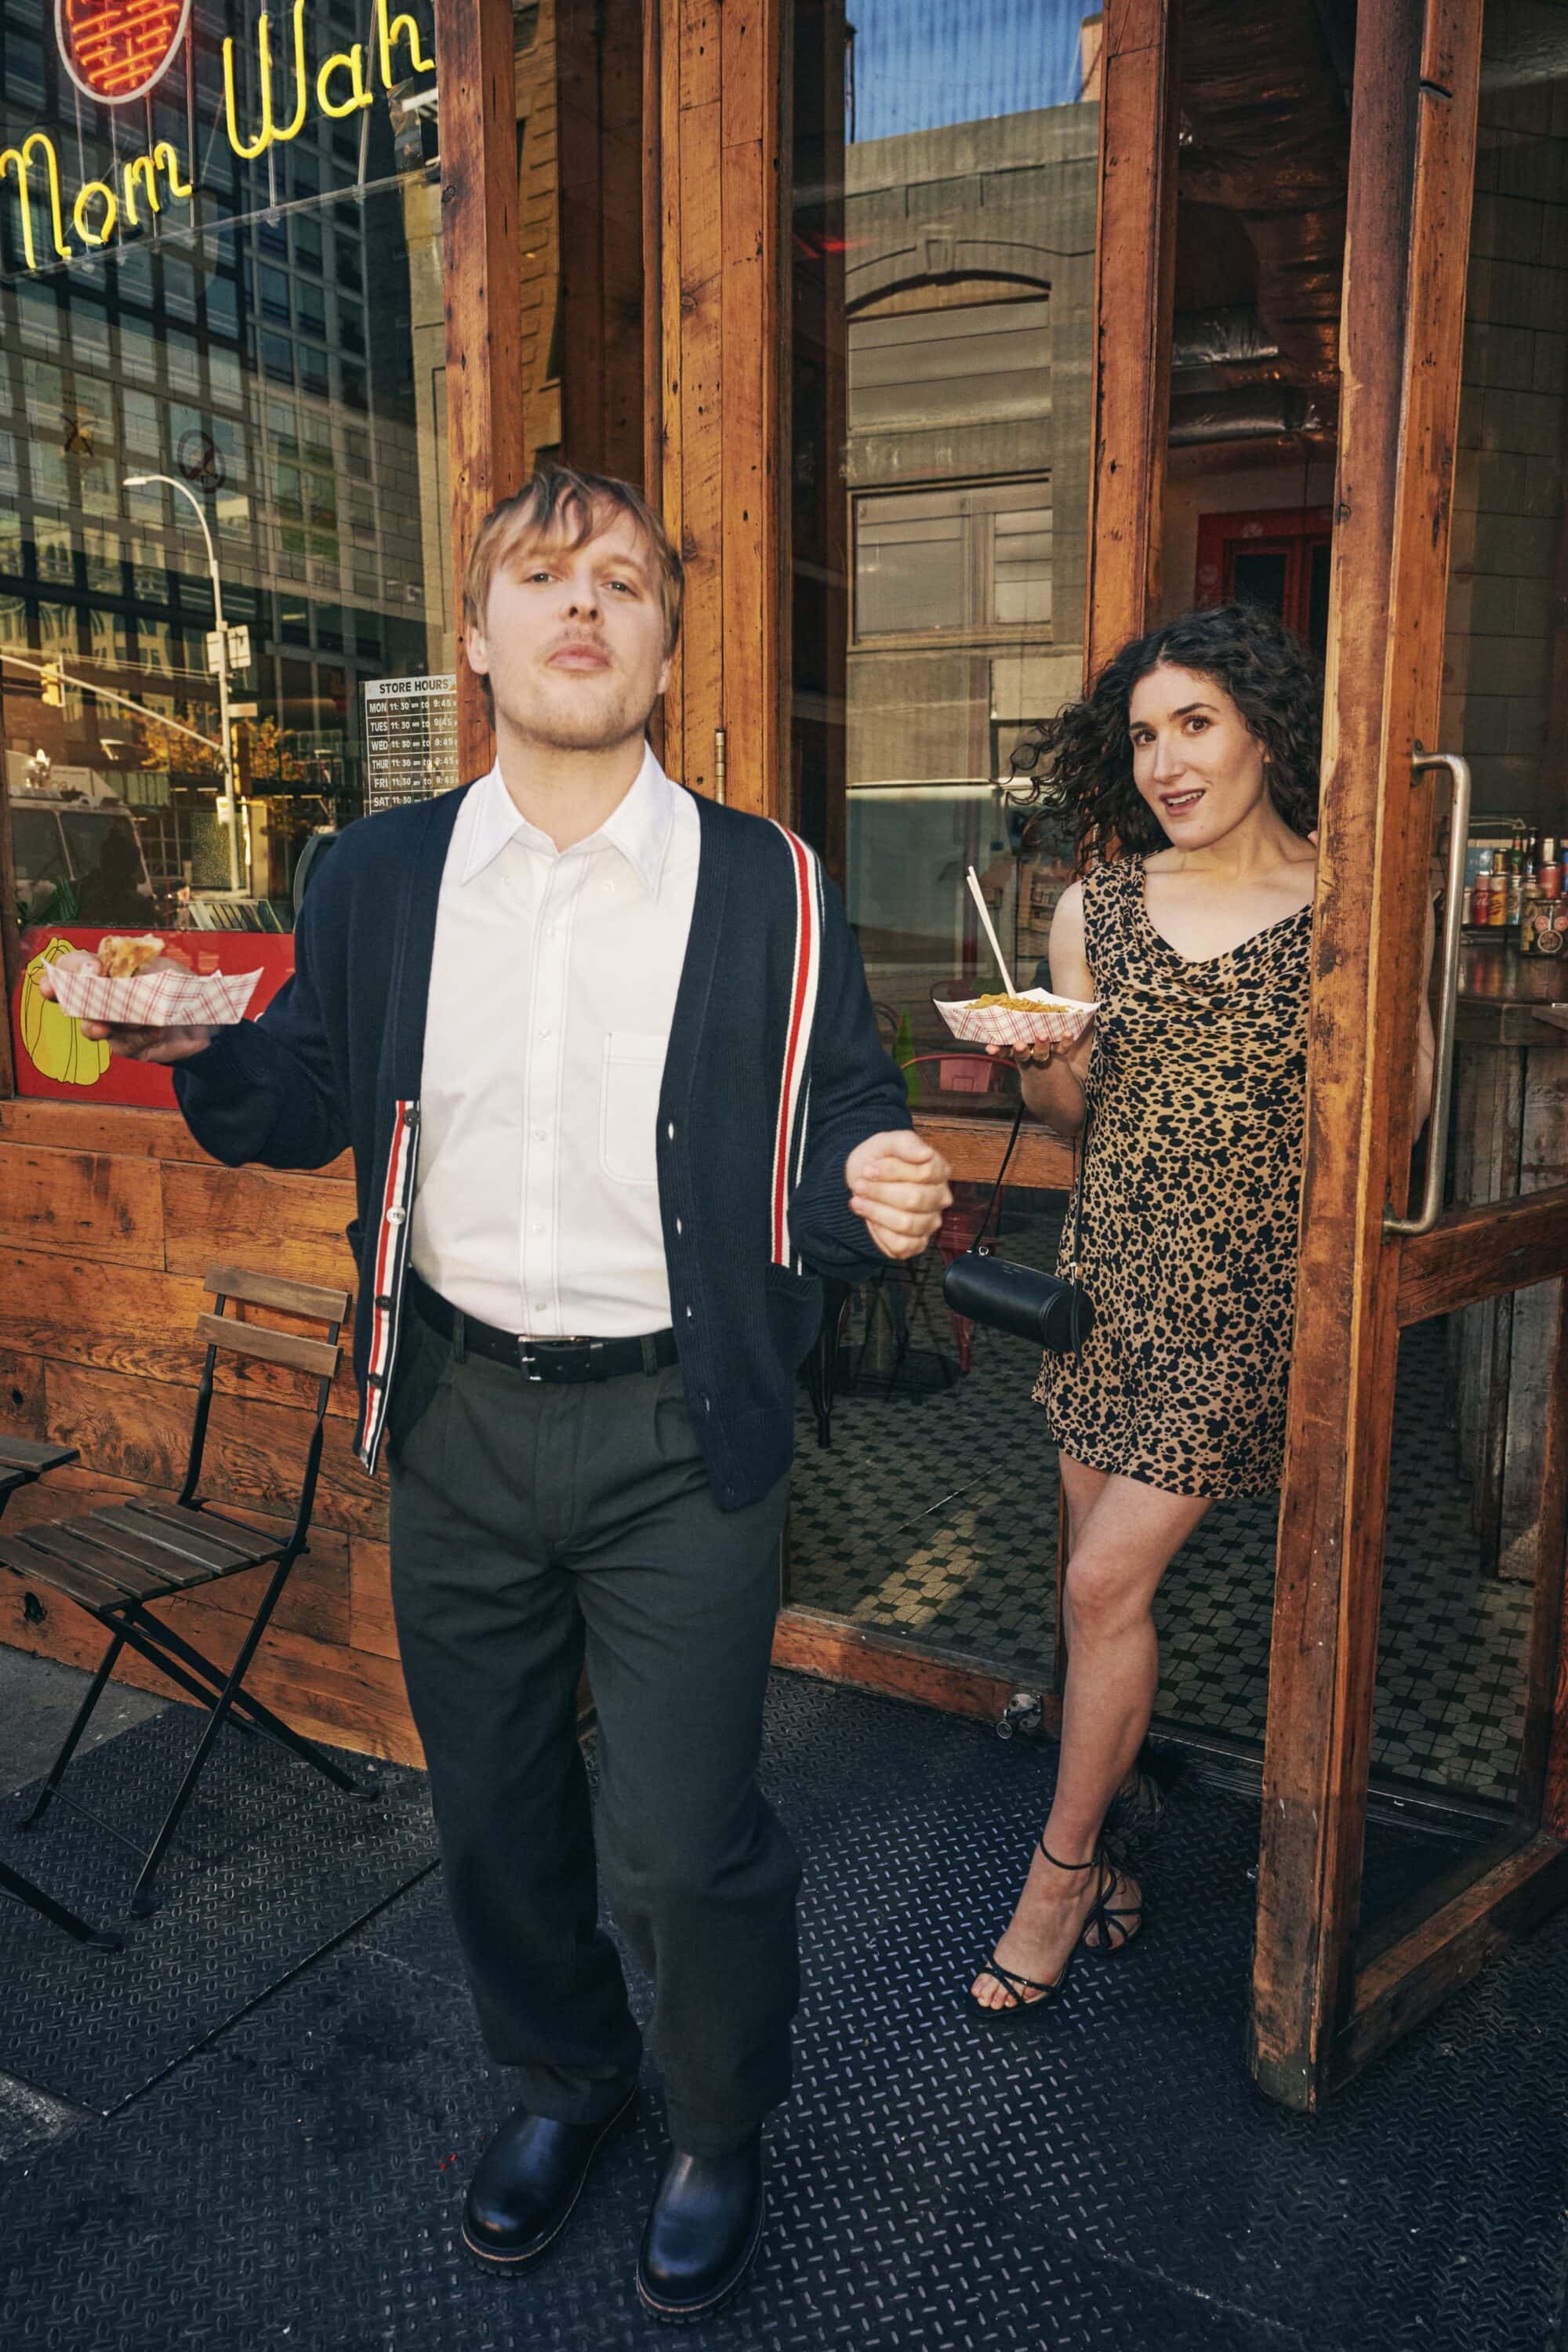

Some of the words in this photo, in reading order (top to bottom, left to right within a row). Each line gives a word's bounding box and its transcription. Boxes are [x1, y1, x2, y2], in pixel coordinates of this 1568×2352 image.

[0, 130, 193, 271] Nom
[223, 0, 437, 159] Wah
[379, 681, 411, 694] STORE
[415, 679, 448, 691] HOURS
[369, 702, 387, 713] MON
[370, 721, 387, 732] TUES
[372, 741, 387, 750] WED
[372, 760, 389, 770] THUR
[375, 778, 388, 788] FRI
[374, 797, 389, 807] SAT
